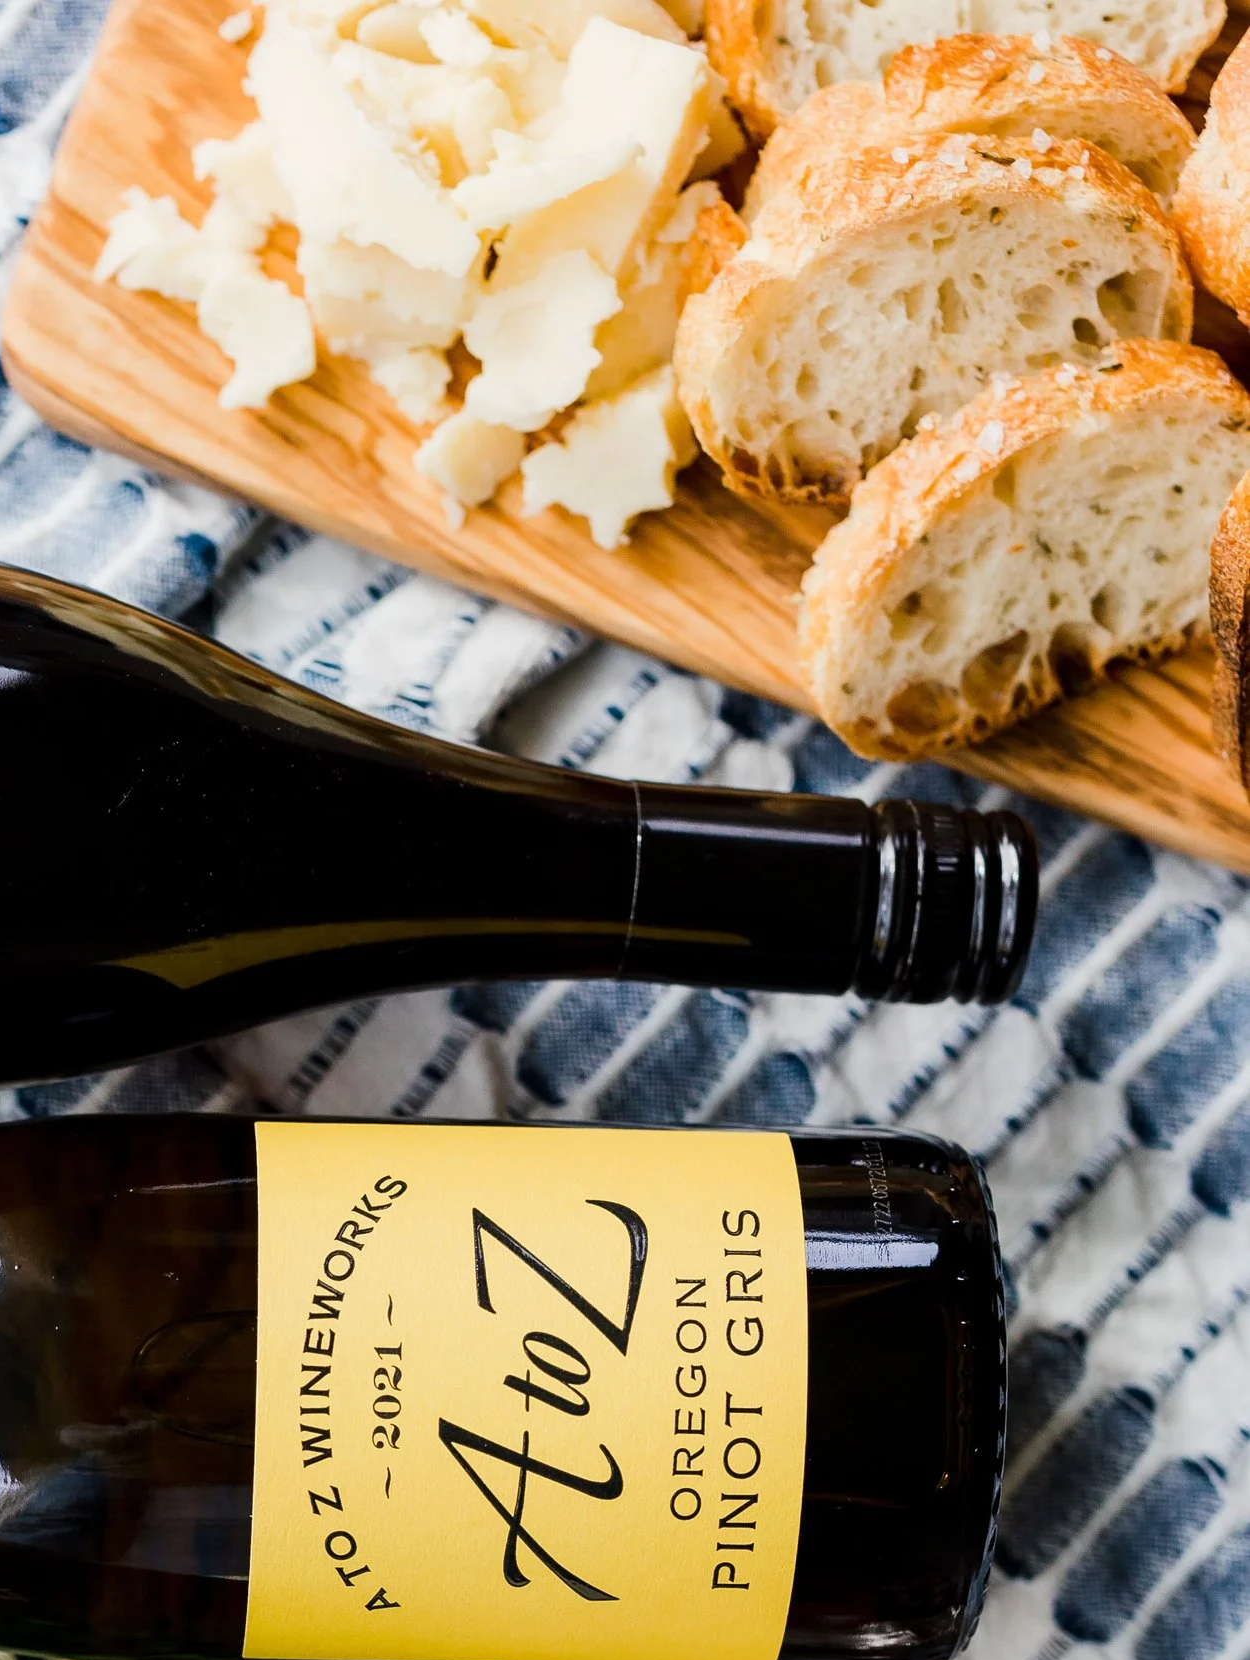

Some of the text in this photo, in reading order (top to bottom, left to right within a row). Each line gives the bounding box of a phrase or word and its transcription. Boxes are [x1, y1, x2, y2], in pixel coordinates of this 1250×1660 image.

[299, 1174, 408, 1611] A TO Z WINEWORKS
[371, 1341, 403, 1450] 2021
[669, 1277, 707, 1521] OREGON
[711, 1209, 764, 1591] PINOT GRIS
